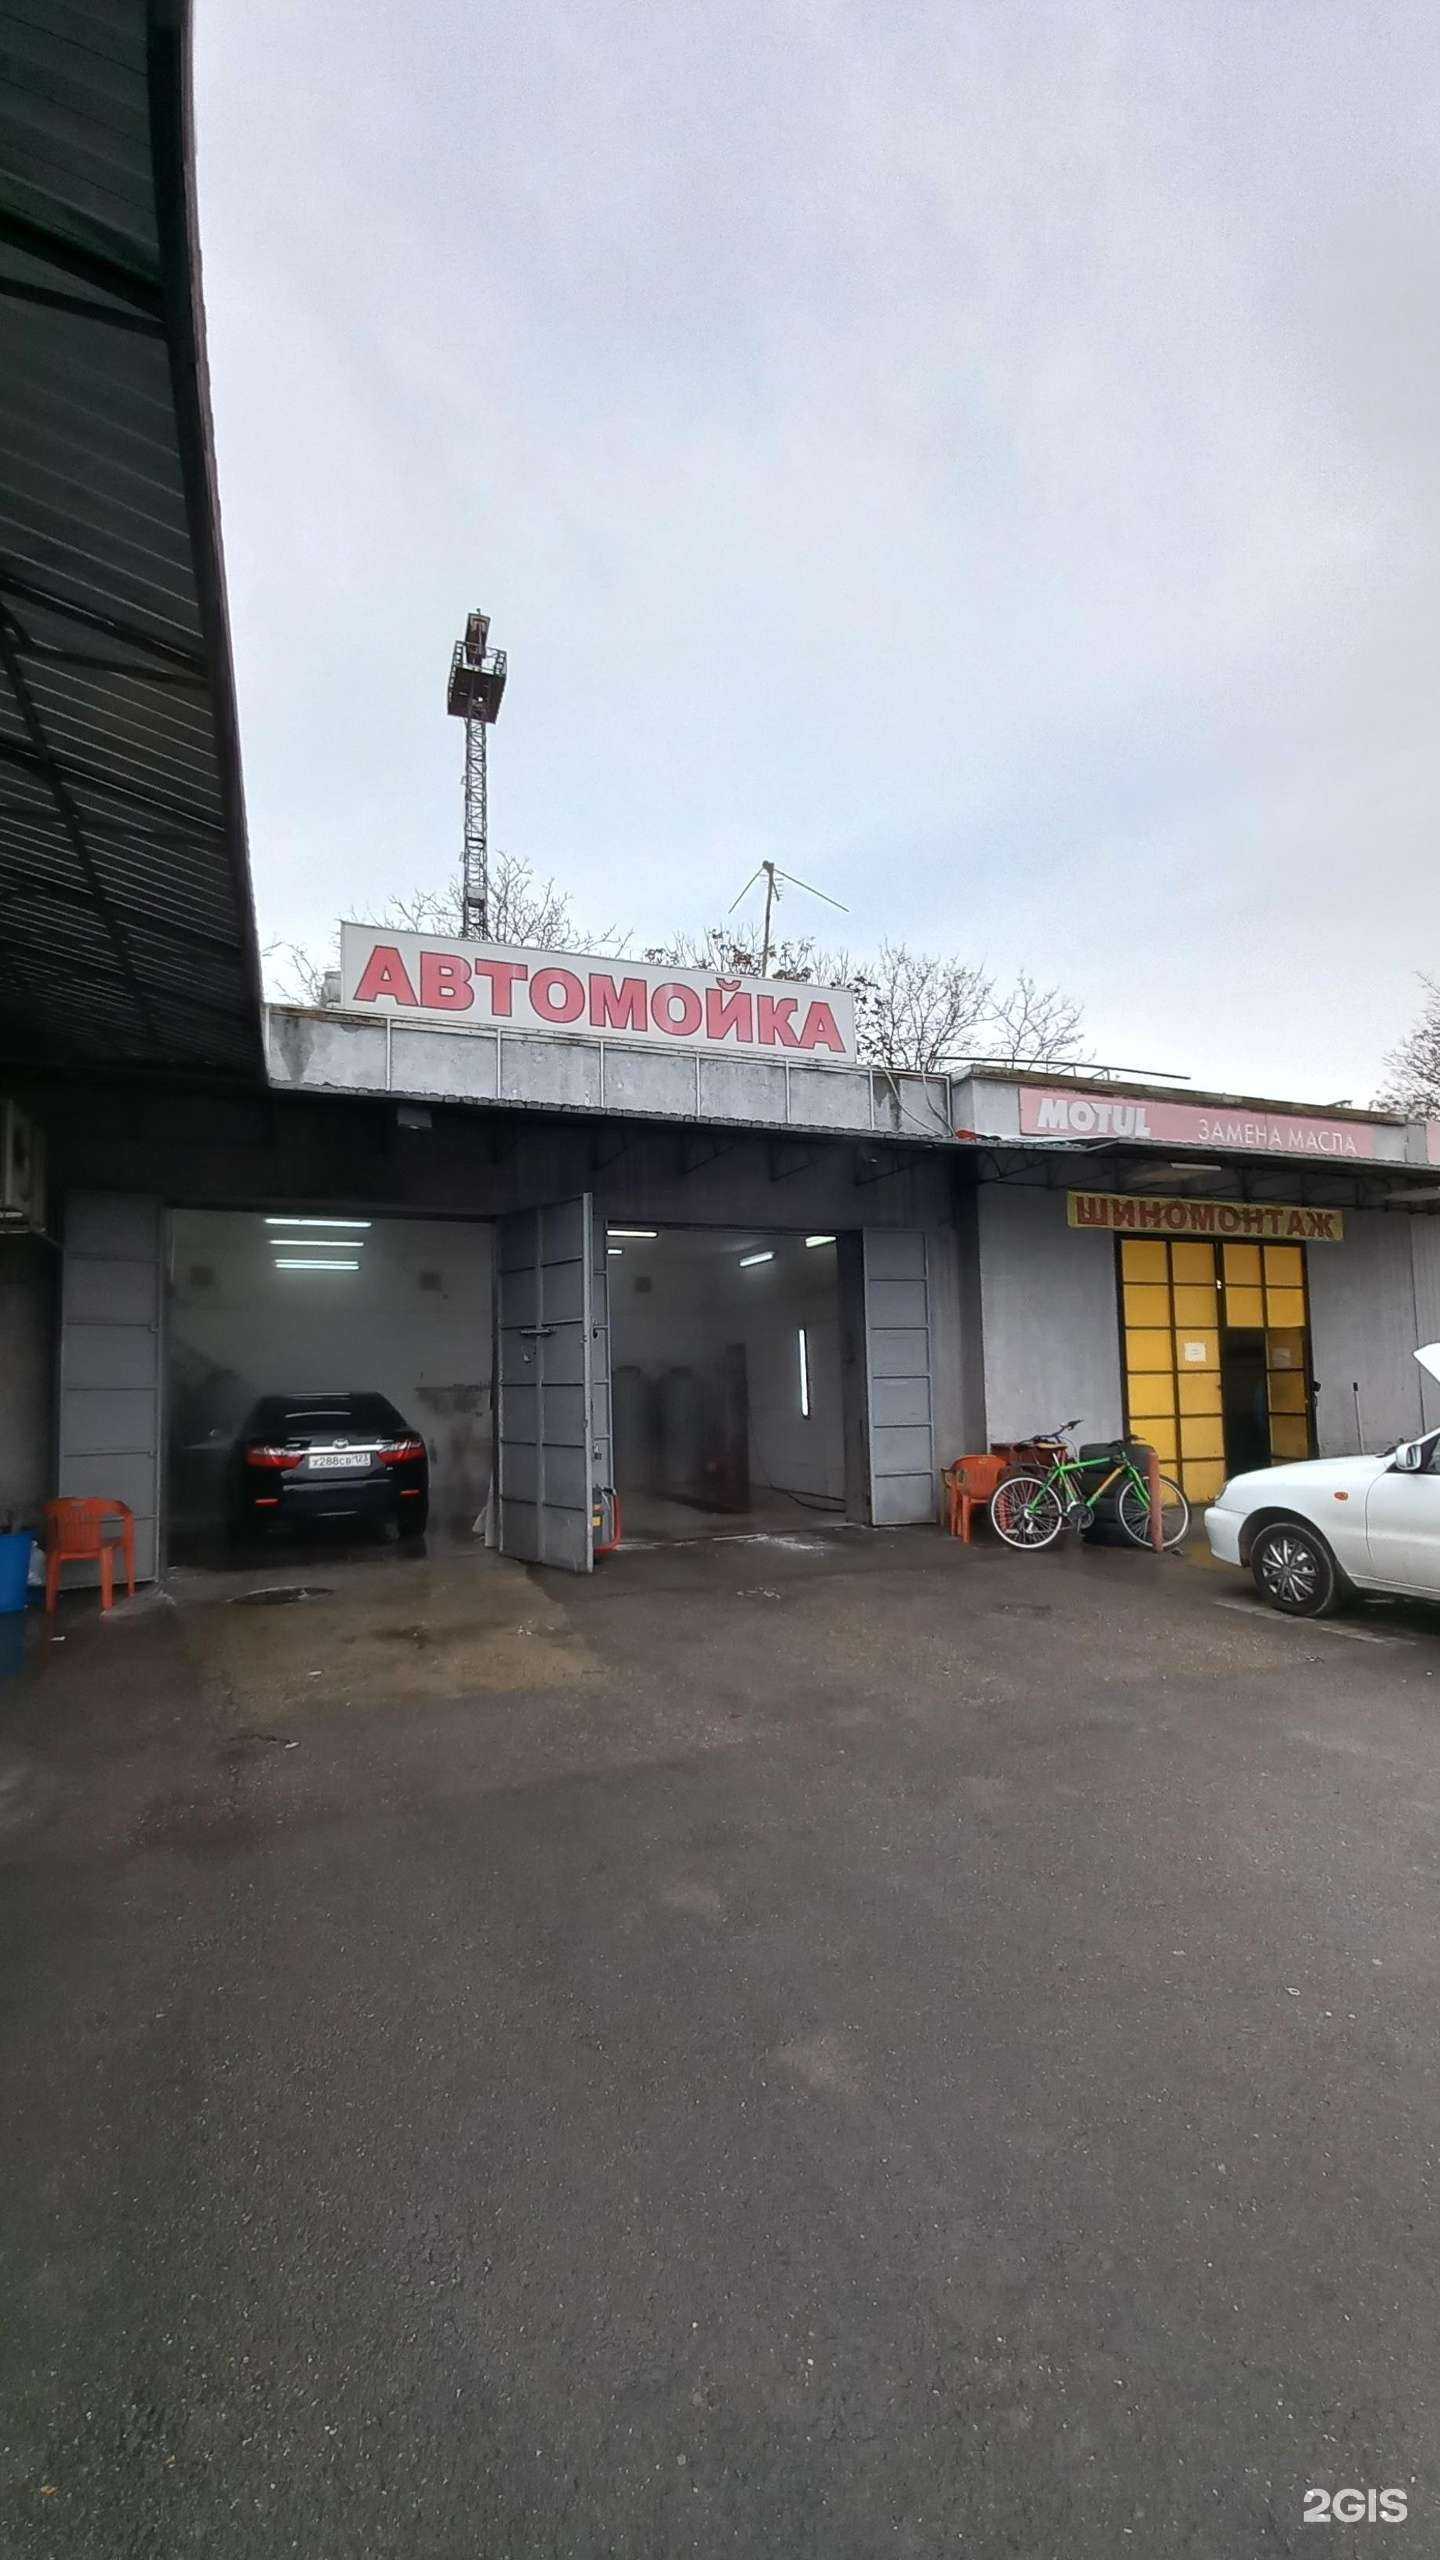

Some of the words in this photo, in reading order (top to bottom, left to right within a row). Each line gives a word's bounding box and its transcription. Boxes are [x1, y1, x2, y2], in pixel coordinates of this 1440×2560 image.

[354, 945, 846, 1053] АВТОМОЙКА
[1037, 1098, 1151, 1137] MOTUL
[1198, 1118, 1282, 1146] ЗАМЕНА
[1288, 1127, 1358, 1154] МАСЛА
[1075, 1196, 1334, 1239] ШИНОМОНТАЖ
